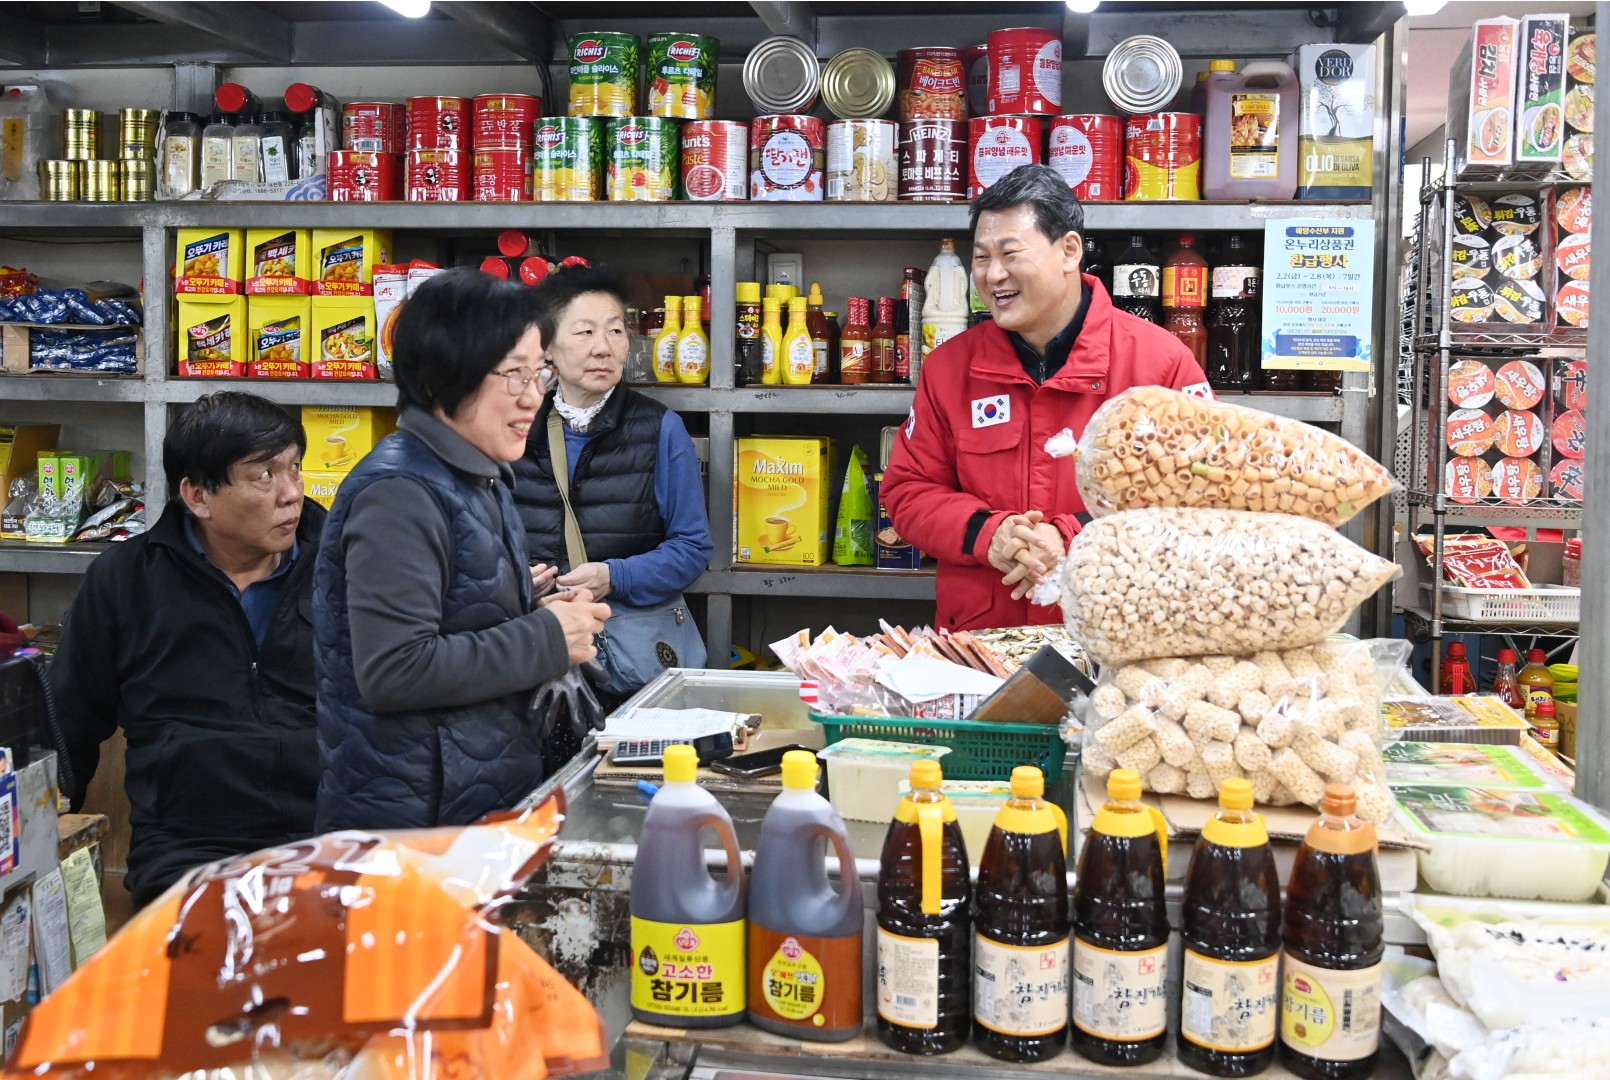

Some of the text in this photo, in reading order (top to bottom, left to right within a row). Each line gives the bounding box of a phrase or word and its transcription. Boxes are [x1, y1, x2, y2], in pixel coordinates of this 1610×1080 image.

[576, 46, 602, 57] RICHIS
[670, 46, 698, 56] RICHIS
[1529, 29, 1552, 75] 육개장
[1318, 57, 1352, 68] VERD
[1478, 43, 1497, 79] 김치
[912, 128, 950, 141] HEINZ
[1306, 154, 1333, 172] OLIO
[902, 167, 923, 181] 토마토
[1493, 205, 1536, 222] 튀김우동
[1295, 227, 1329, 235] 해양수산부
[186, 240, 211, 259] 오뚜기
[1285, 239, 1354, 250] 온누리상품권
[267, 246, 295, 259] 백세카
[1565, 247, 1592, 267] 새우
[1290, 253, 1348, 268] 환급행사
[189, 278, 211, 287] 오뚜기
[259, 278, 279, 287] 오뚜기
[1131, 269, 1149, 288] 우동
[325, 282, 345, 291] 오뚜기
[195, 362, 215, 371] 오뚜기
[262, 362, 282, 371] 오뚜기
[326, 362, 346, 371] 오뚜기
[1504, 369, 1537, 397] 새우탕
[1452, 419, 1485, 441] 새우탕
[1512, 413, 1530, 449] 새우탕
[753, 459, 803, 475] Maxim
[662, 963, 713, 979] 고소한
[651, 979, 724, 1003] 참기름
[769, 979, 815, 1003] 참기름
